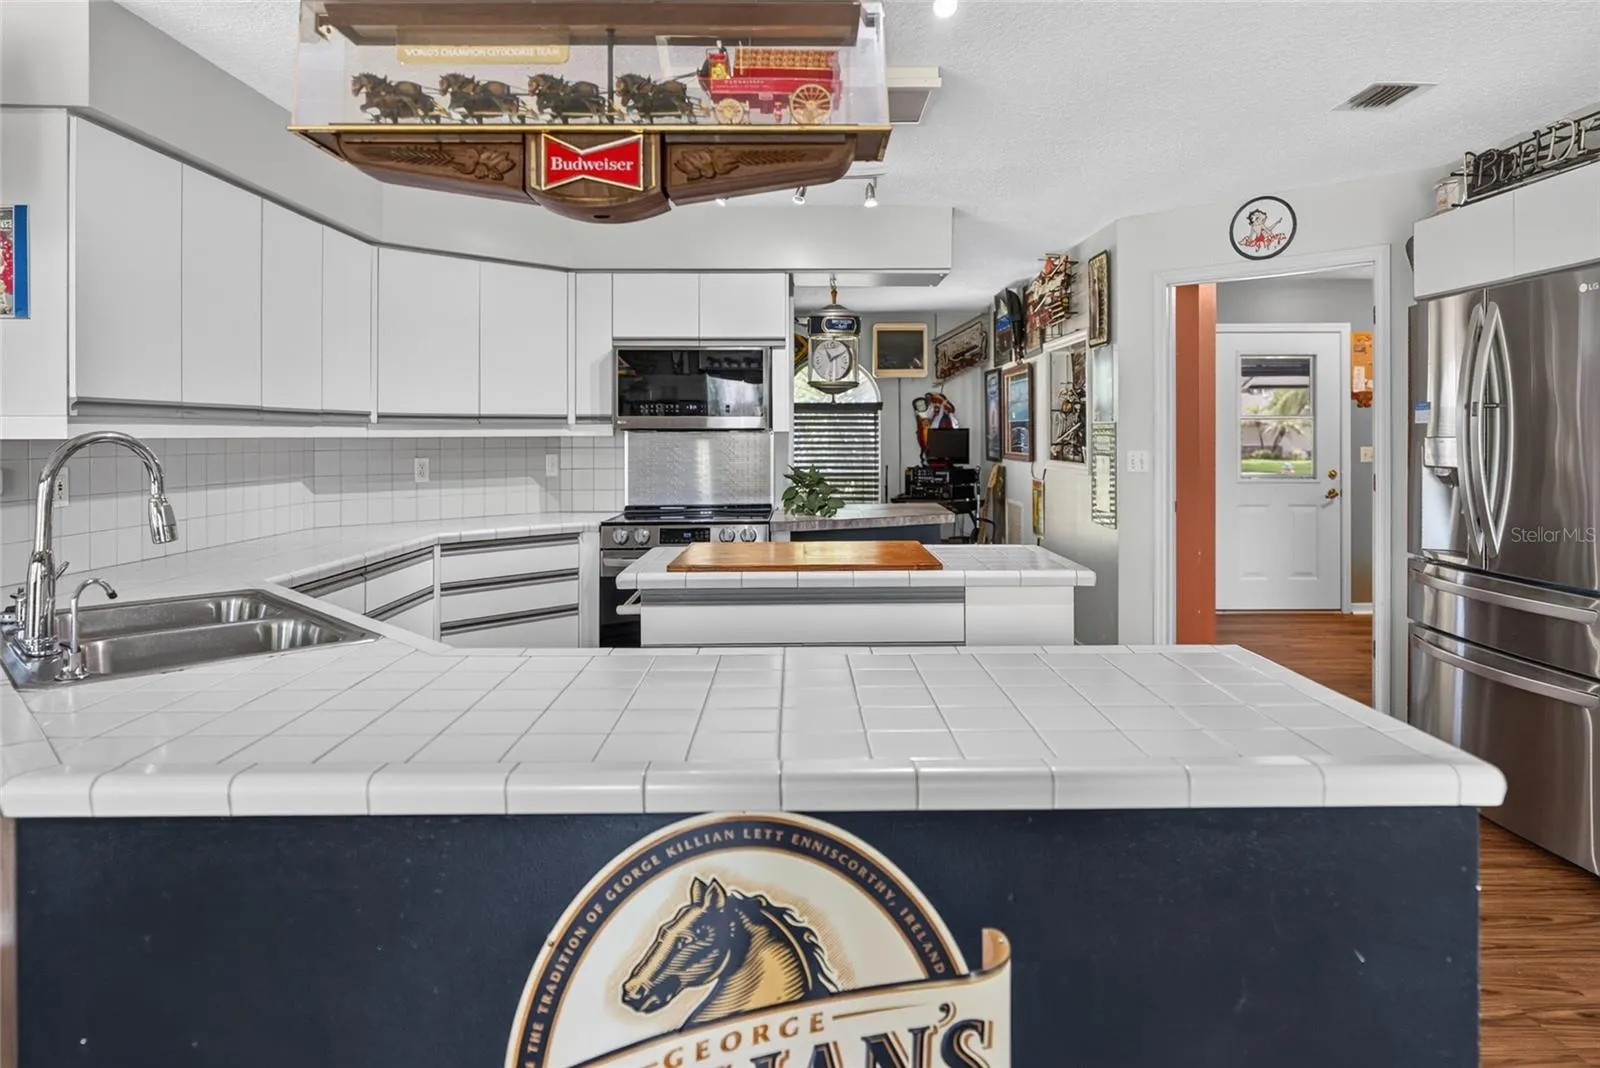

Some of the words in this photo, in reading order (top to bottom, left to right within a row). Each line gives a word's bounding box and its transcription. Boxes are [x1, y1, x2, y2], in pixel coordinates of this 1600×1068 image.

[550, 156, 634, 171] Budweiser
[527, 1022, 544, 1054] THE
[537, 926, 588, 1014] TRADITION
[586, 903, 604, 923] OF
[605, 855, 662, 901] GEORGE
[665, 829, 734, 858] KILLIAN
[743, 828, 784, 841] LETT
[791, 834, 896, 906] ENNISCORTHY,
[900, 907, 945, 974] IRELAND
[663, 1012, 825, 1068] GEORGE
